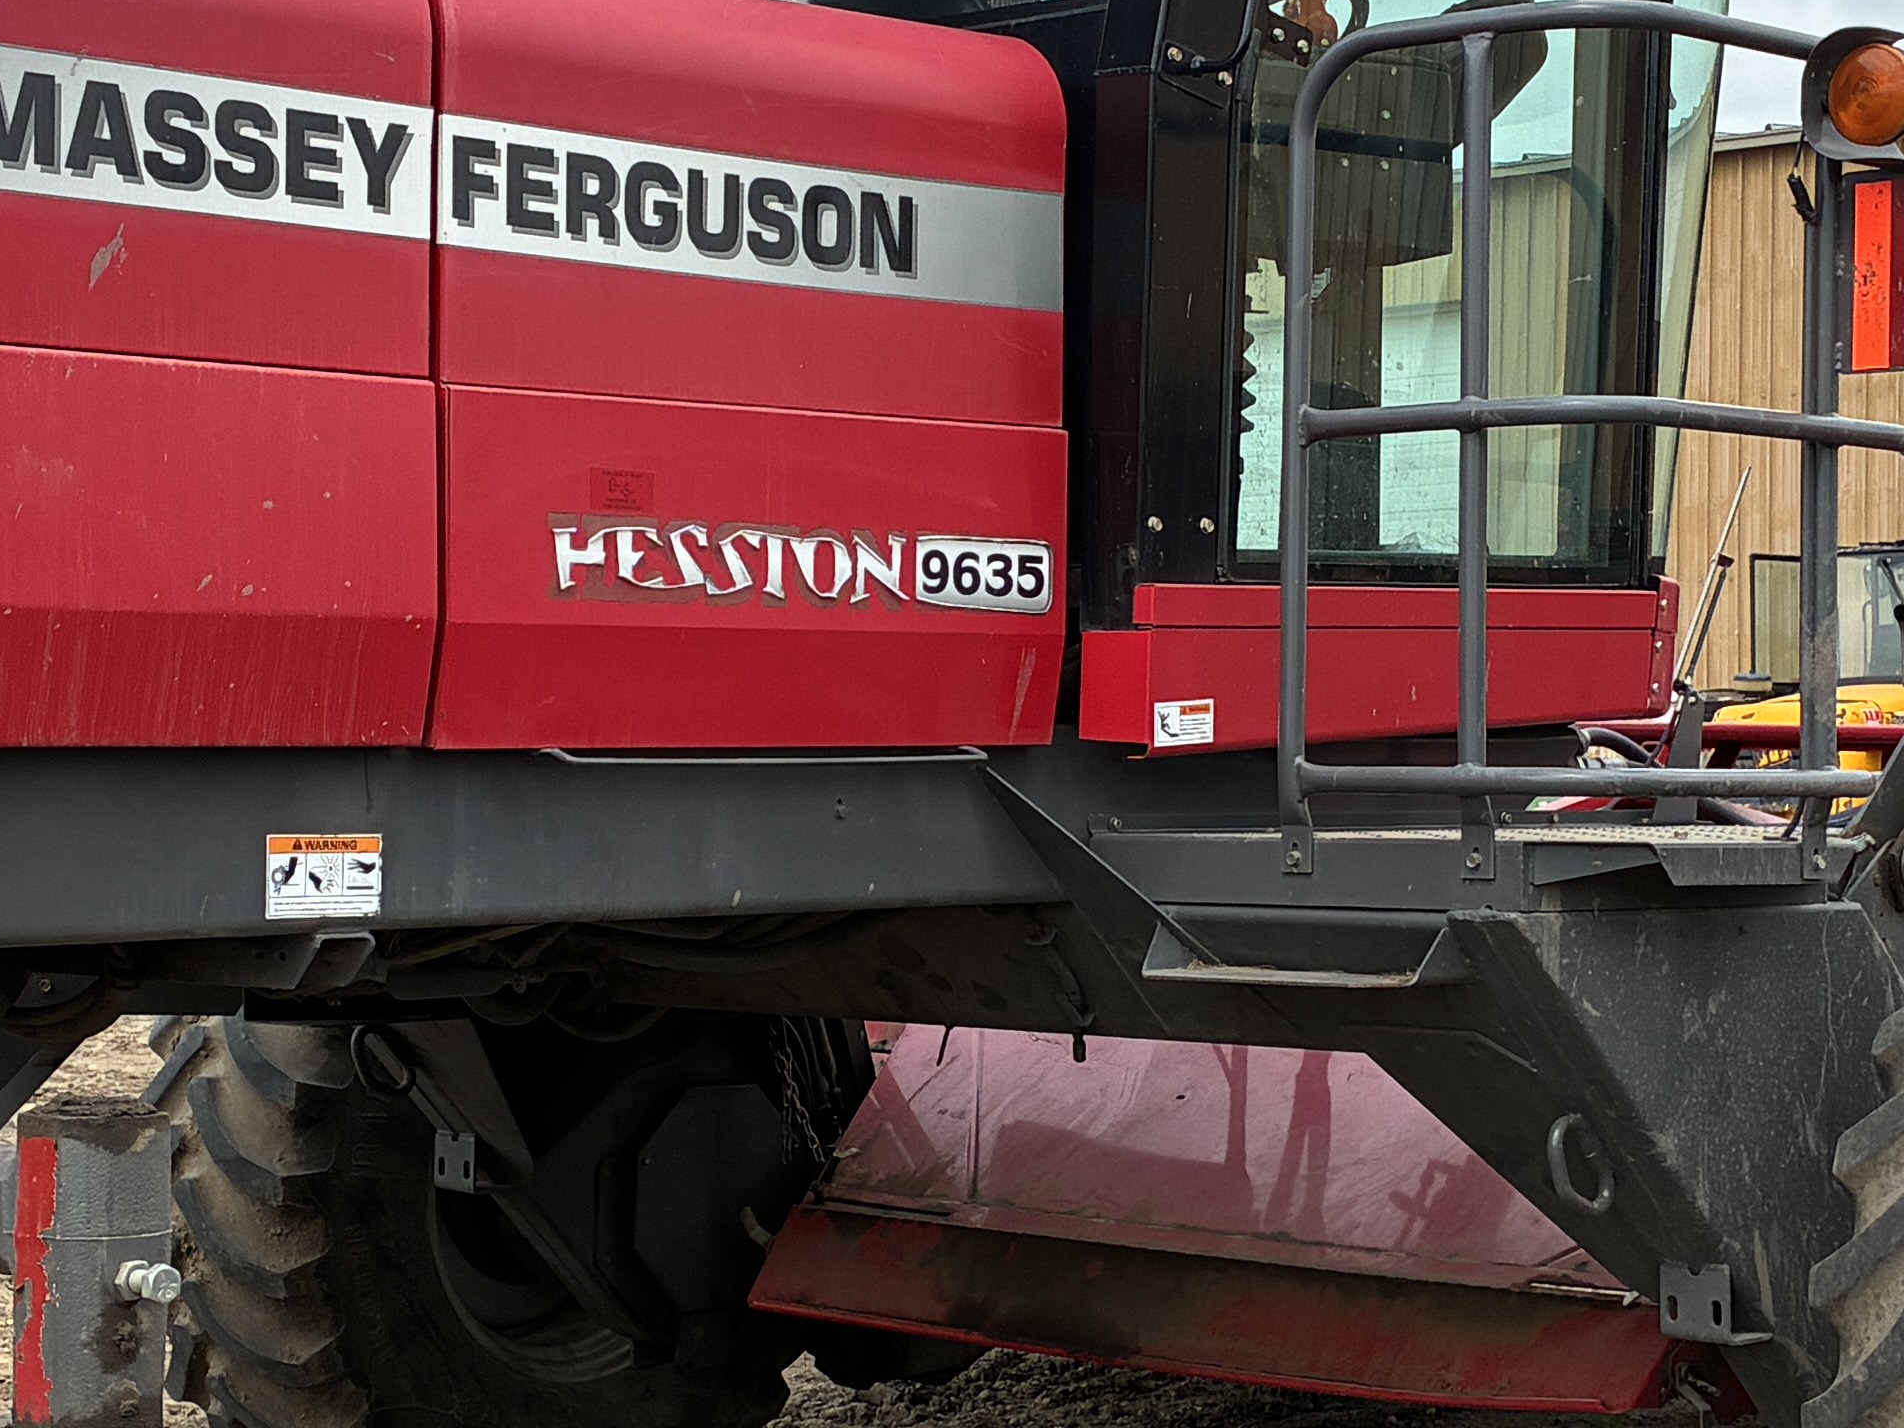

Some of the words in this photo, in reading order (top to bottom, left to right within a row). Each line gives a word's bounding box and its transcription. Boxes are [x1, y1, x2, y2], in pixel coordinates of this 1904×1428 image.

[449, 135, 918, 280] FERGUSON
[551, 525, 908, 603] HESSTON
[919, 548, 1048, 599] 9635
[304, 839, 358, 851] WARNING
